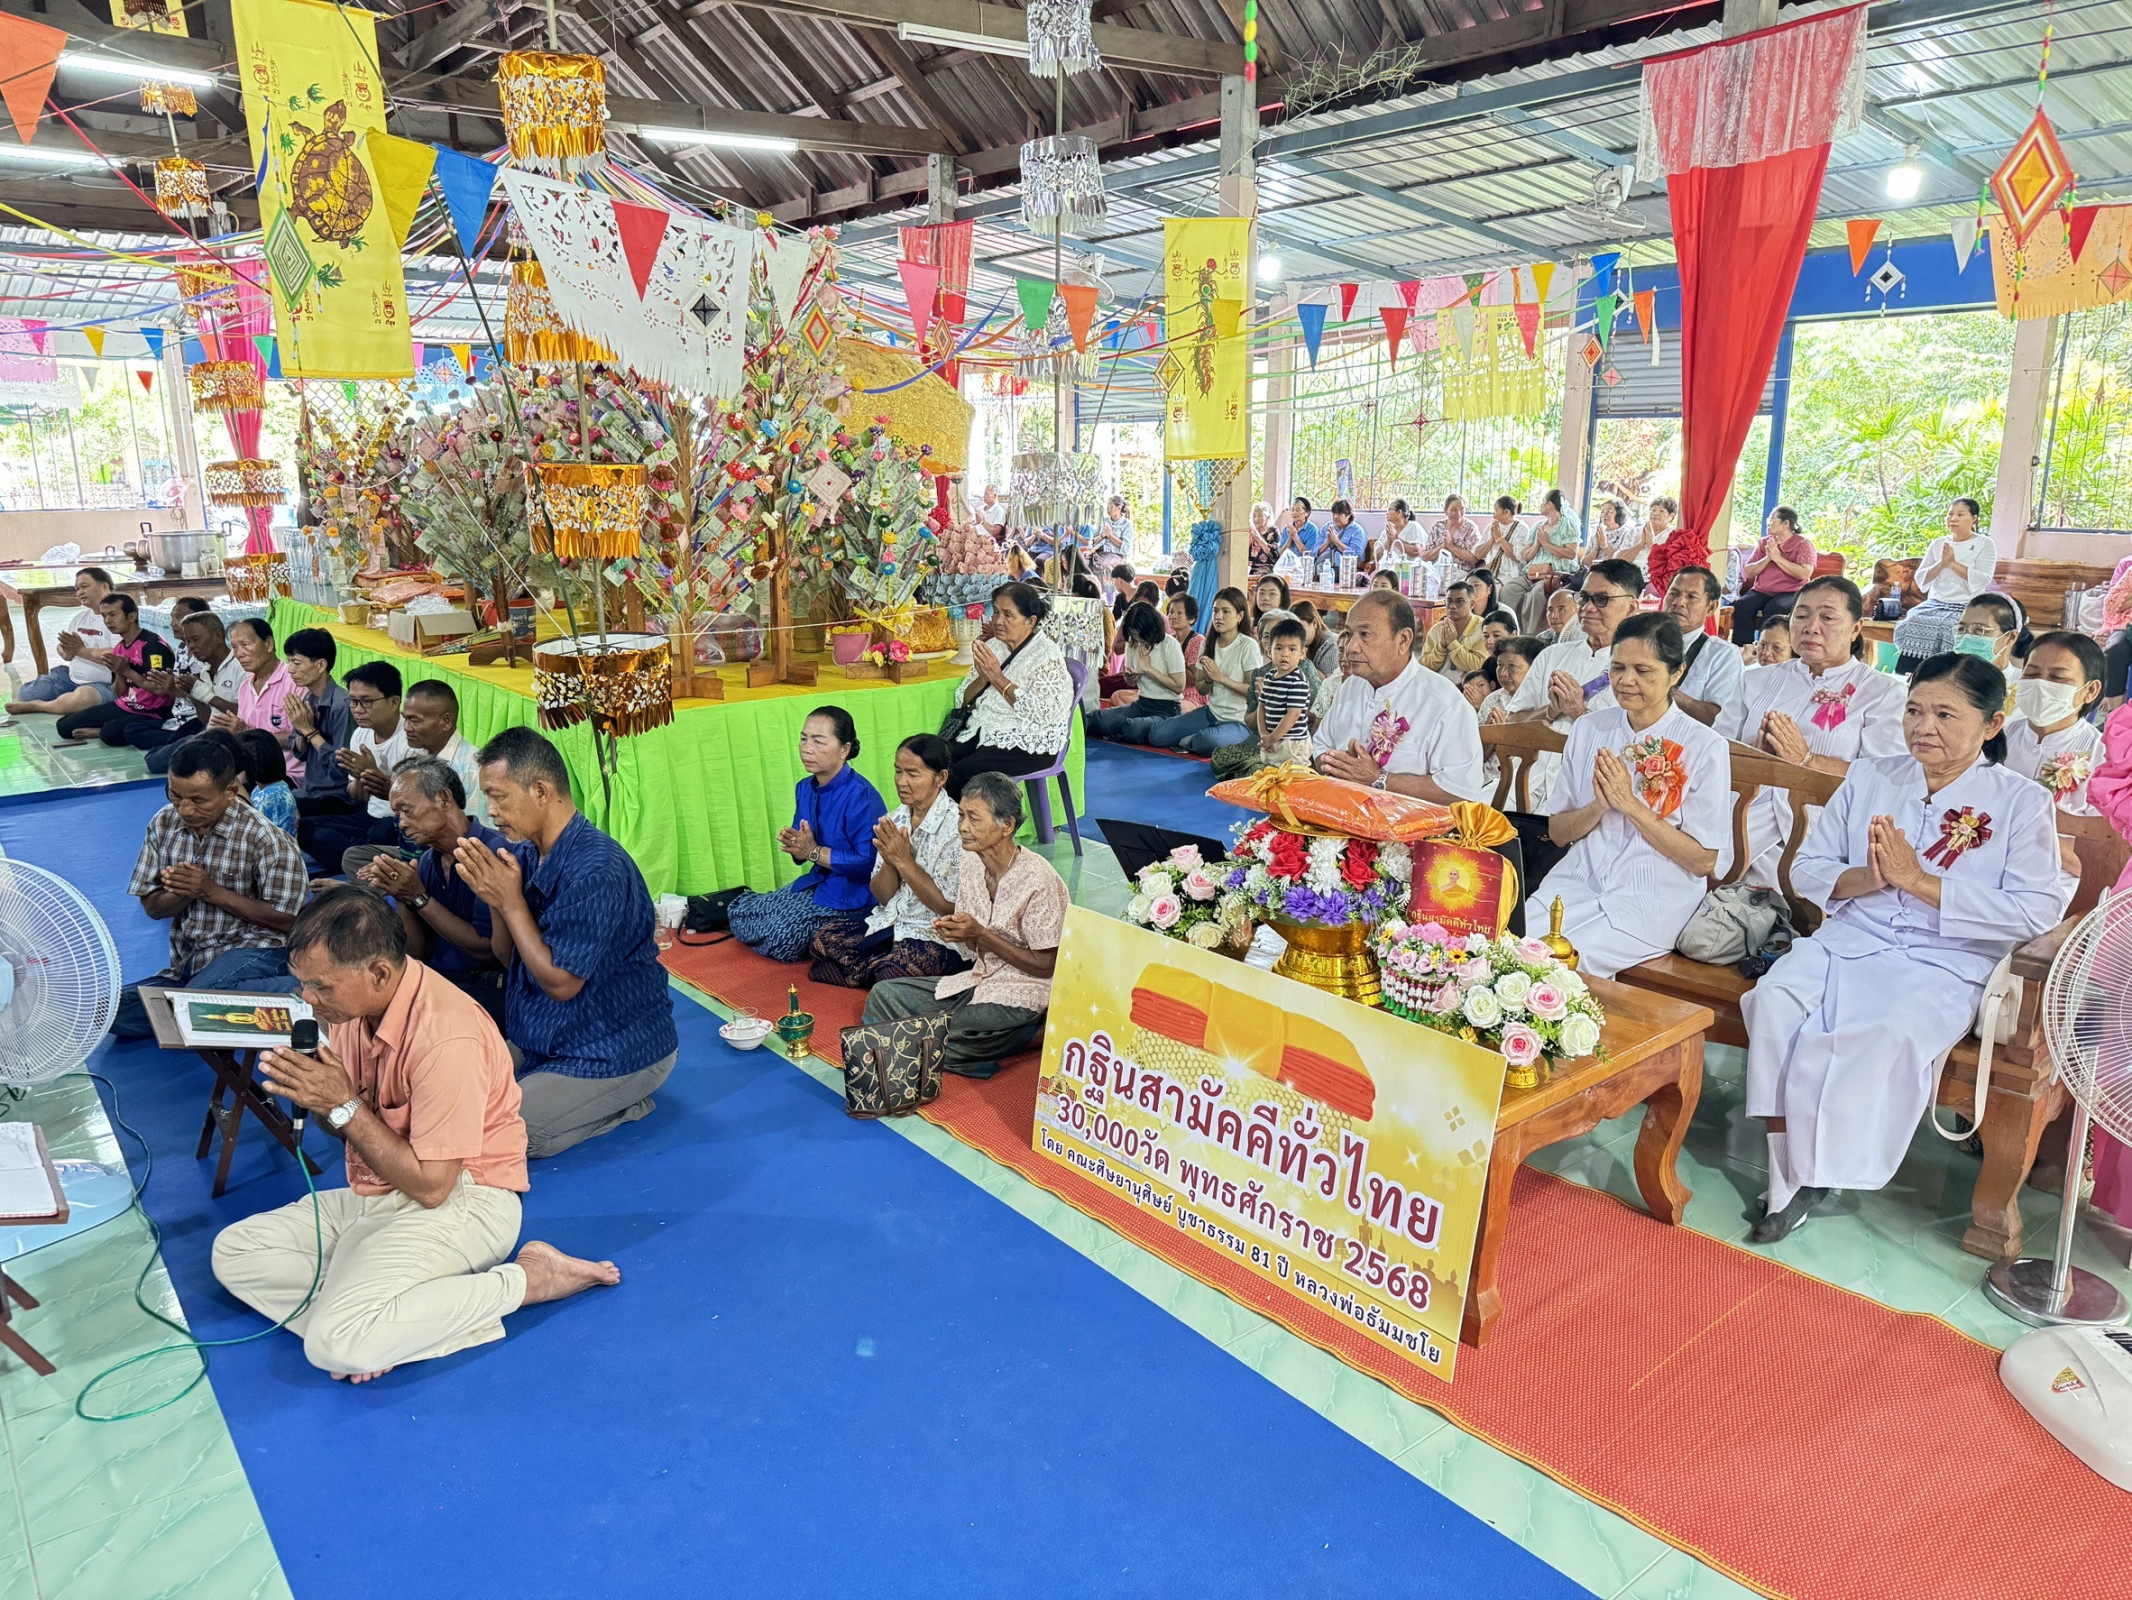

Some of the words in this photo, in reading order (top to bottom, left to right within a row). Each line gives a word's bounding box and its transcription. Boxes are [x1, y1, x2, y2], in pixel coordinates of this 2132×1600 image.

[1065, 1034, 1439, 1244] กฐินสามัคคีทั่วไทย
[1180, 1159, 1335, 1259] พุทธศักราช
[1344, 1241, 1429, 1310] 2568
[1041, 1128, 1063, 1155] โดย
[1067, 1149, 1174, 1214] คณะศิษยานุศิษย์
[1178, 1207, 1245, 1255] บูชาธรรม
[1251, 1246, 1269, 1269] 81
[1277, 1255, 1289, 1278] ปี
[1295, 1271, 1441, 1363] หลวงพ่อธัมมชโย
